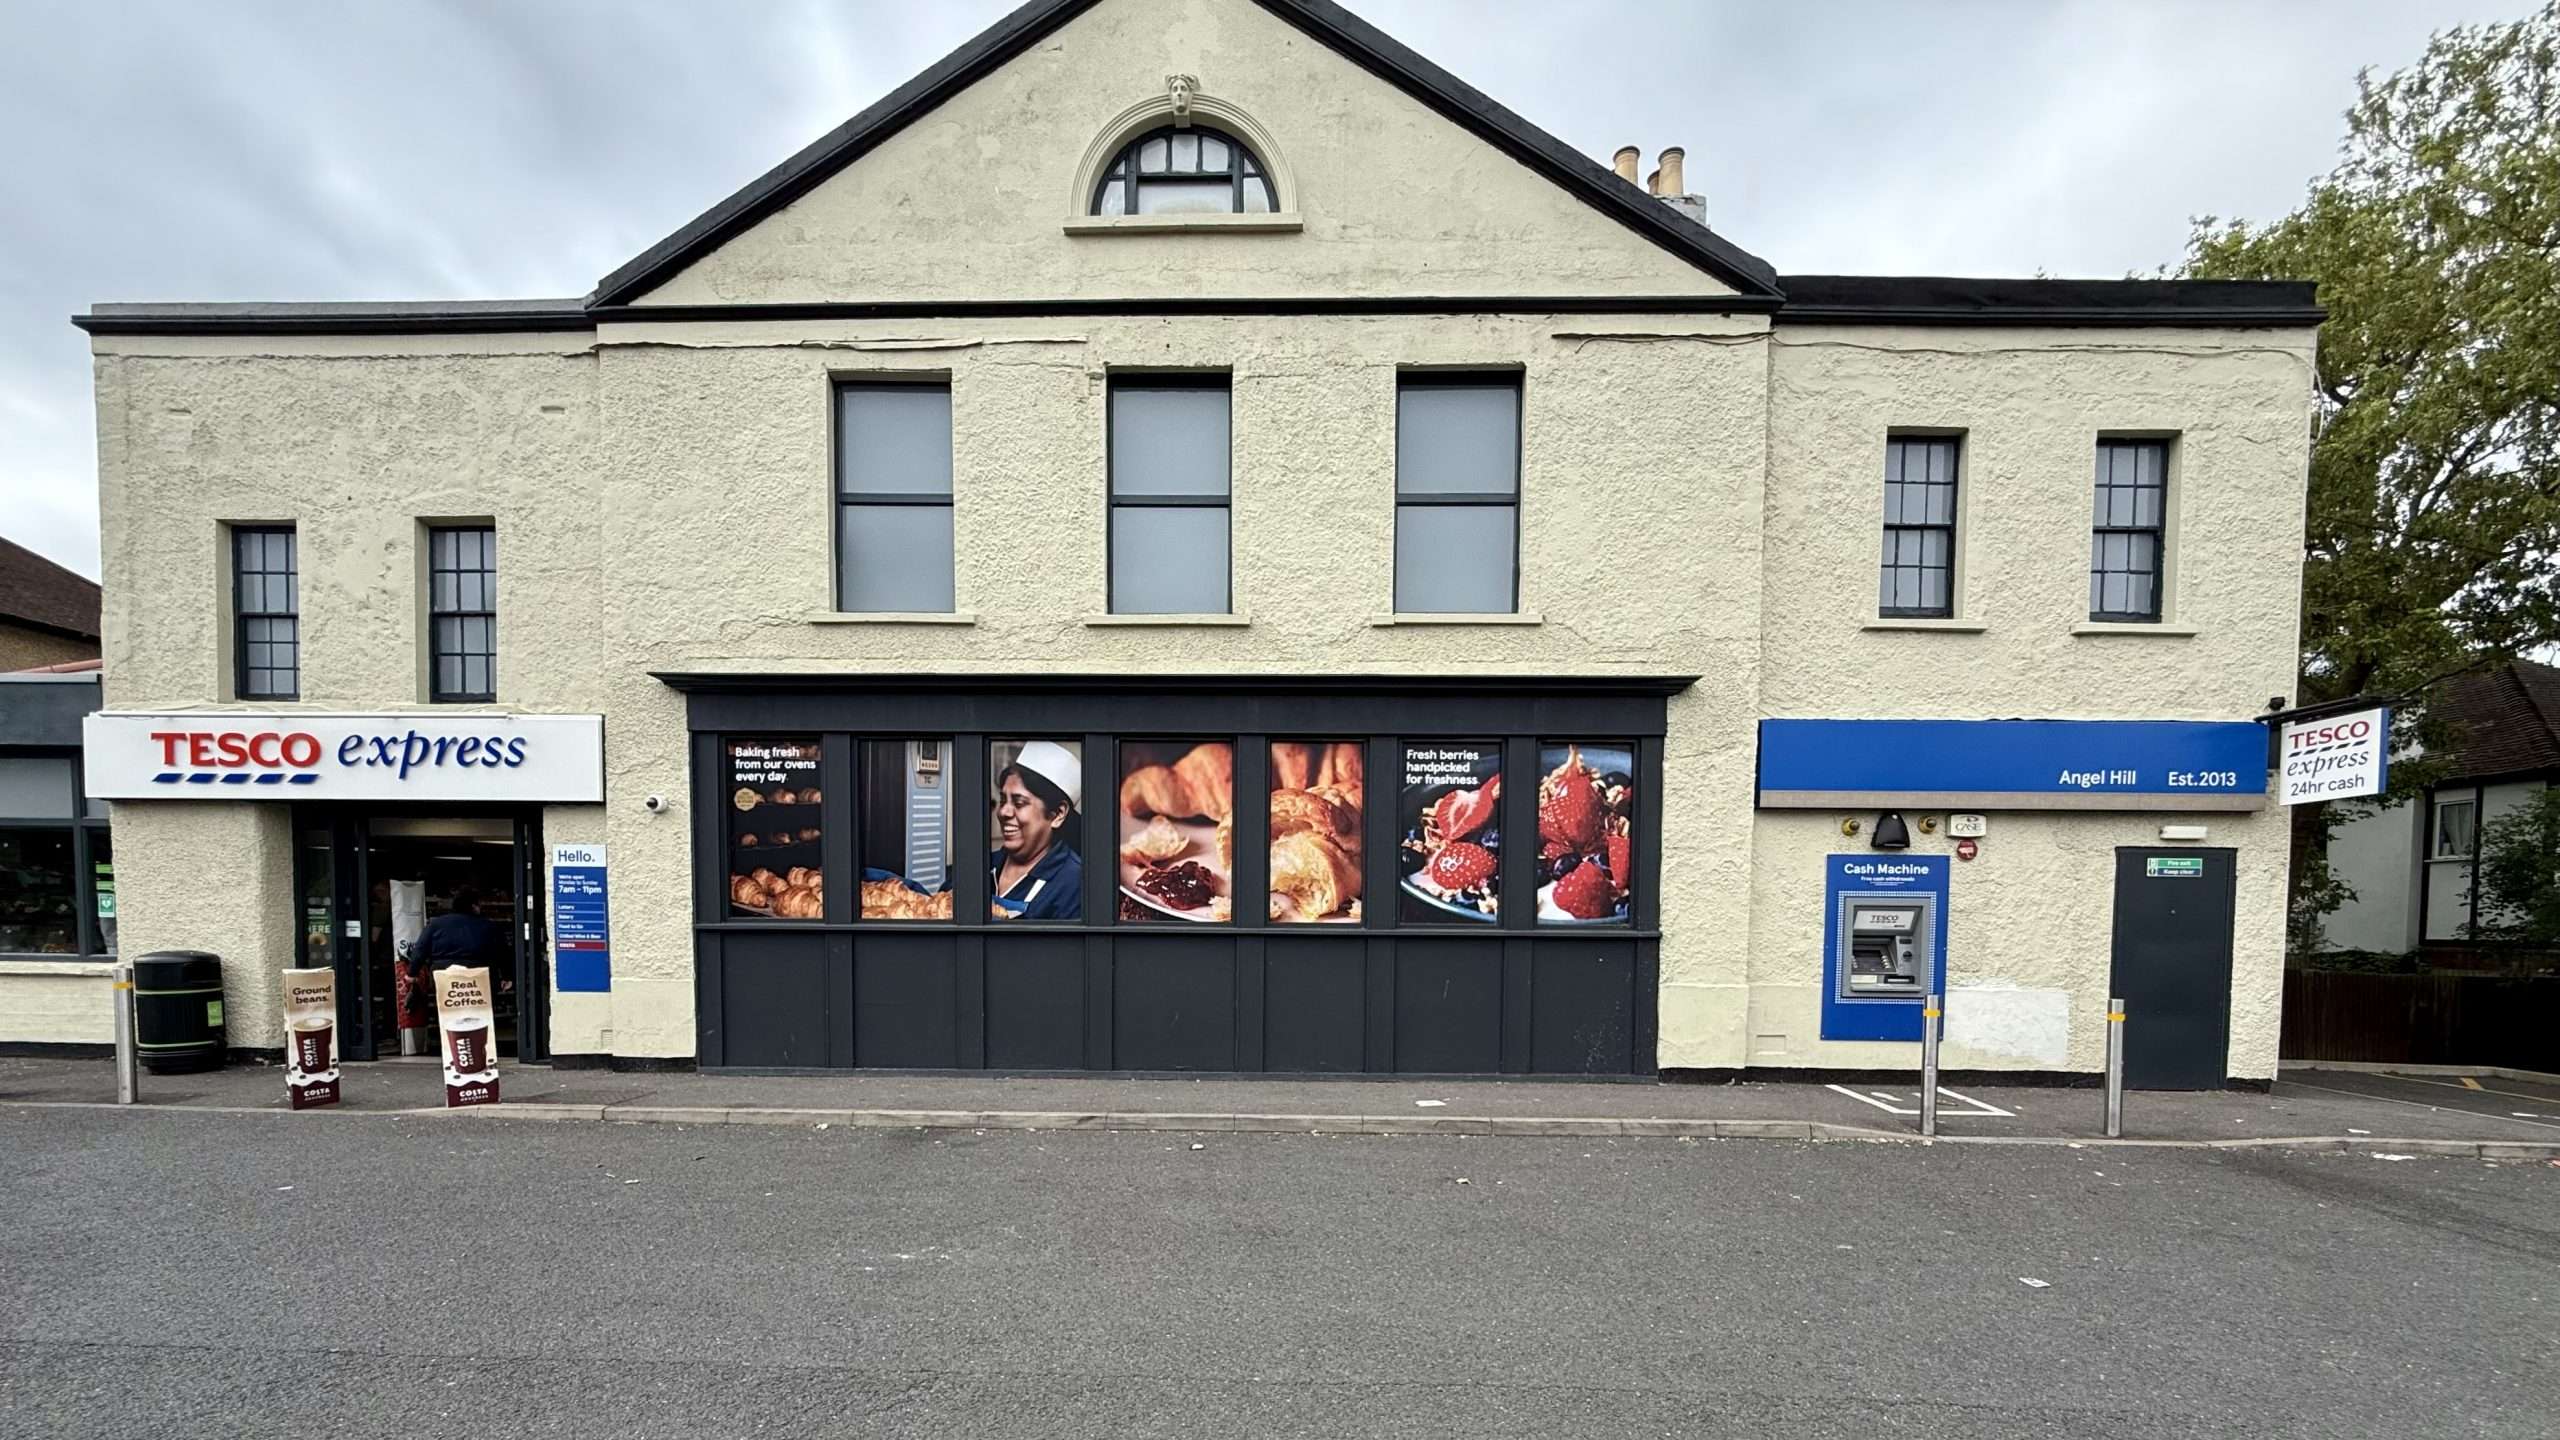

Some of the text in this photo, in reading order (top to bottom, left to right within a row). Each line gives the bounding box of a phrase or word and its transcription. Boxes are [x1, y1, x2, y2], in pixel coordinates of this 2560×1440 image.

[2288, 721, 2370, 749] TESCO
[150, 730, 529, 780] TESCO express
[735, 747, 800, 760] Baking fresh
[1406, 749, 1479, 760] Fresh berries
[735, 759, 816, 769] from our ovens
[1406, 762, 1471, 775] handpicked
[2287, 751, 2369, 779] express
[735, 772, 766, 784] every
[1405, 774, 1423, 784] for
[2058, 770, 2136, 788] Angel Hill
[2168, 772, 2237, 787] Est.2013
[2291, 774, 2365, 796] 24hr cash
[558, 849, 596, 862] Hello.
[1844, 863, 1929, 874] Cash Machine
[558, 885, 576, 893] 7am
[582, 886, 602, 895] 11pm
[1872, 915, 1898, 923] TESCO
[292, 985, 331, 995] Ground
[451, 980, 477, 989] Real
[447, 990, 482, 999] Costa
[444, 998, 487, 1007] Coffee.
[303, 1038, 313, 1067] COSTA
[456, 1038, 469, 1067] COSTA
[303, 1087, 330, 1097] COSTA
[459, 1087, 488, 1097] COSTA
